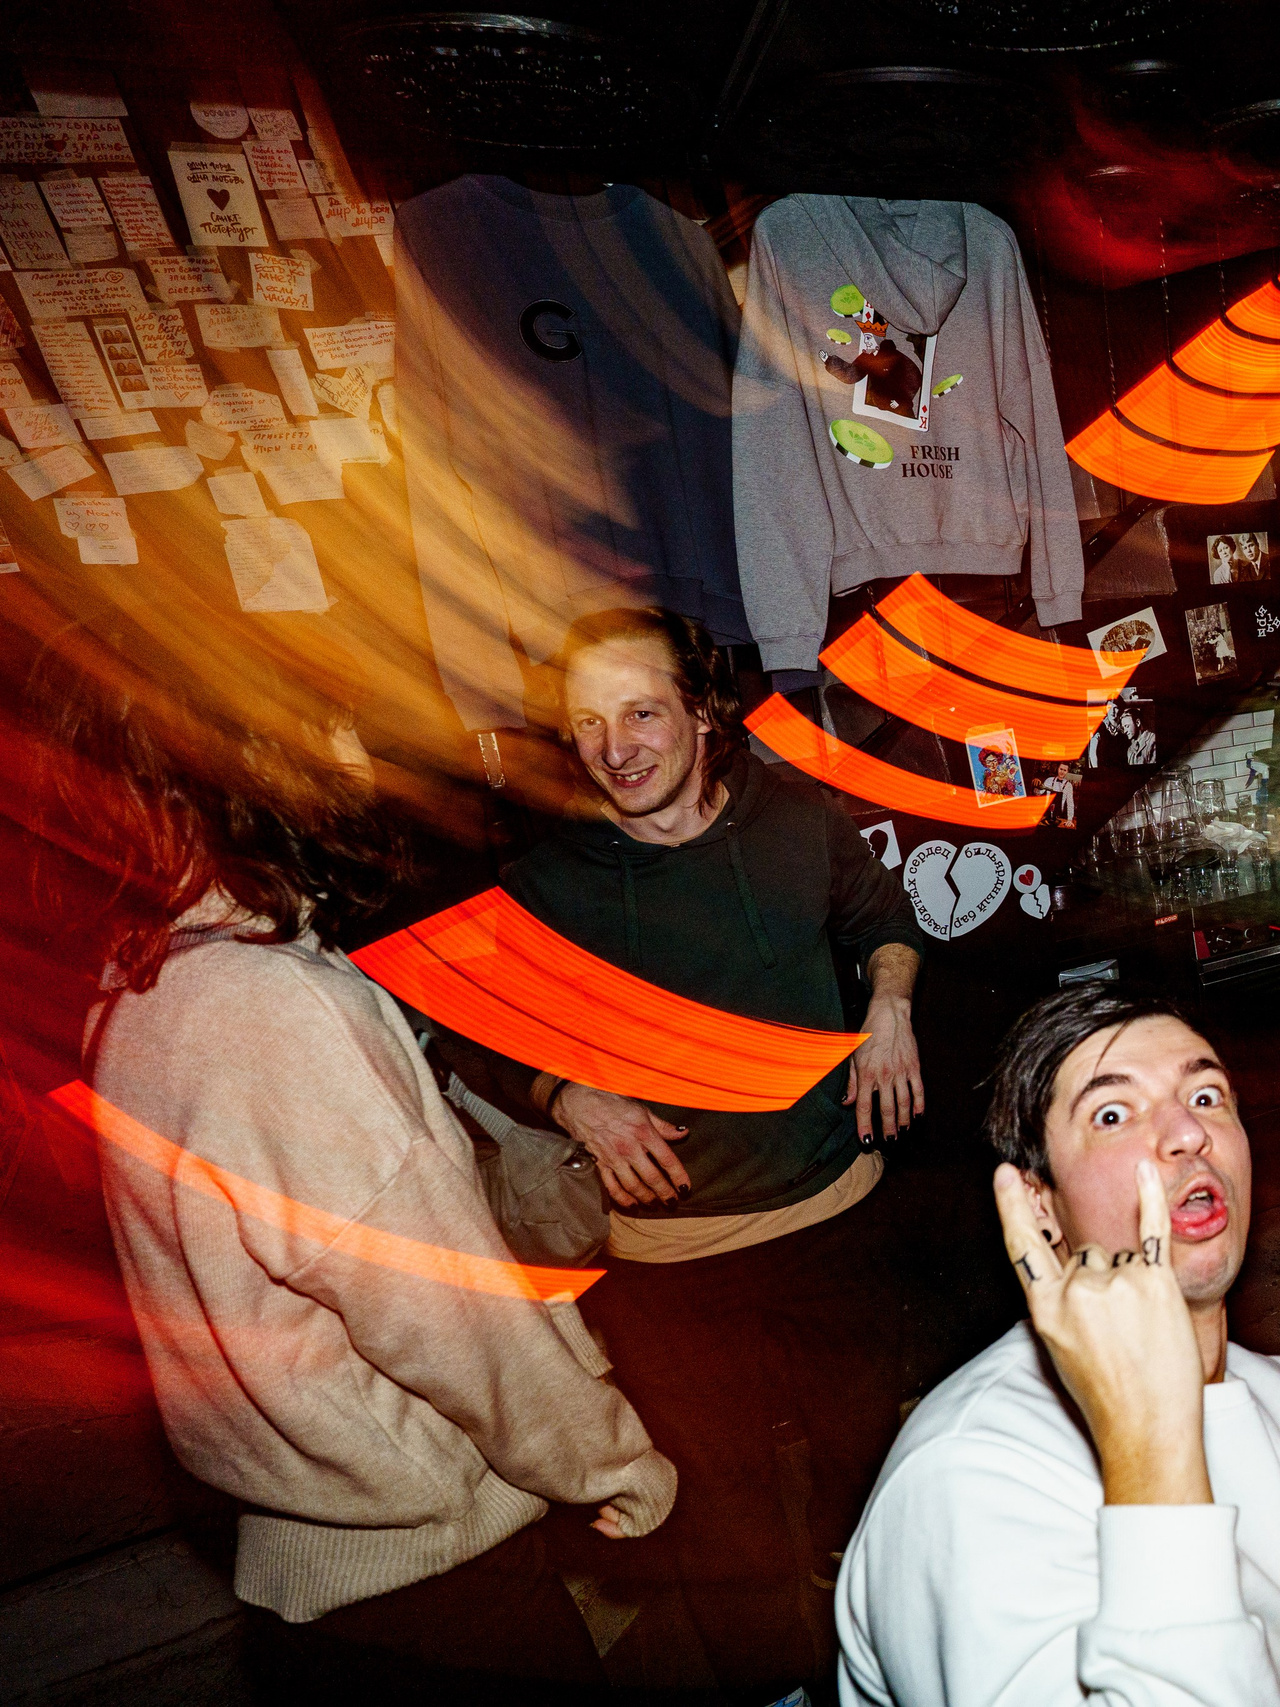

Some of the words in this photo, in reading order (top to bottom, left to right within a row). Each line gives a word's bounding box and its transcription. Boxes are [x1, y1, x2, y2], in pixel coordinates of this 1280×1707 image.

[518, 298, 583, 363] G
[910, 445, 961, 461] FRESH
[901, 463, 953, 479] HOUSE
[908, 845, 952, 875] сердец
[964, 846, 1006, 912] бильярдный
[908, 877, 949, 936] разбитых
[953, 909, 978, 930] бар
